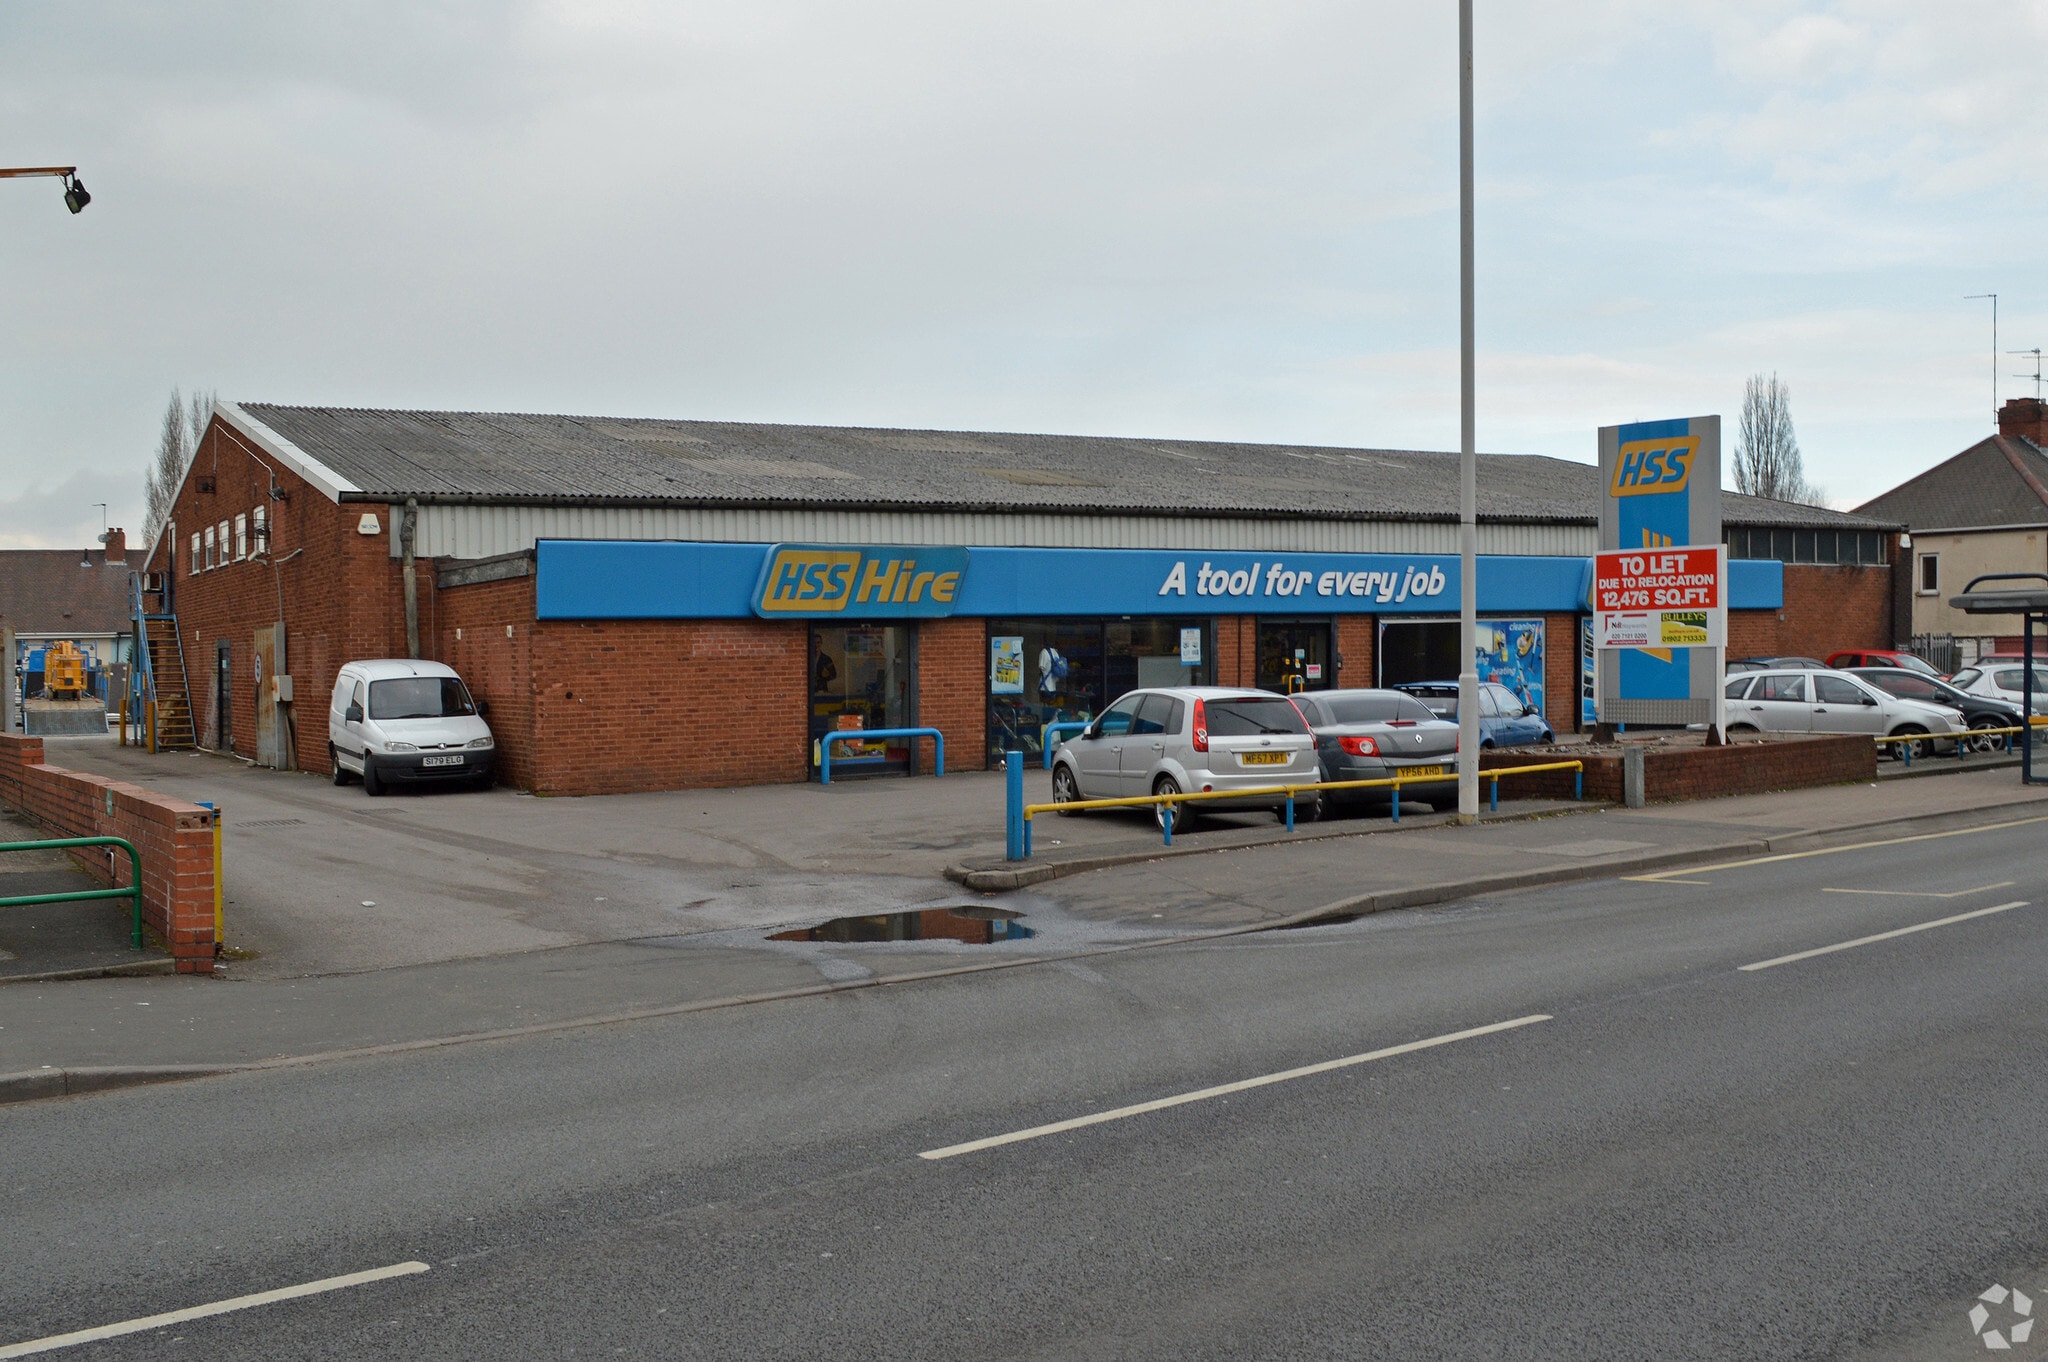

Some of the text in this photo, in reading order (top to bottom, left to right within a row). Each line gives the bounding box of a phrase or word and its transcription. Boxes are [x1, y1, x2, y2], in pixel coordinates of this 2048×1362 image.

[1618, 447, 1690, 487] HSS
[1619, 554, 1688, 576] TO LET
[772, 560, 960, 602] HSS Hire
[1158, 561, 1446, 603] A tool for every job
[1599, 574, 1714, 589] DUE TO RELOCATION
[1602, 588, 1710, 609] 12,476 SQ.FT.
[1509, 622, 1536, 632] cleaning
[1662, 612, 1707, 621] BULLEYS
[1400, 767, 1422, 776] YP56
